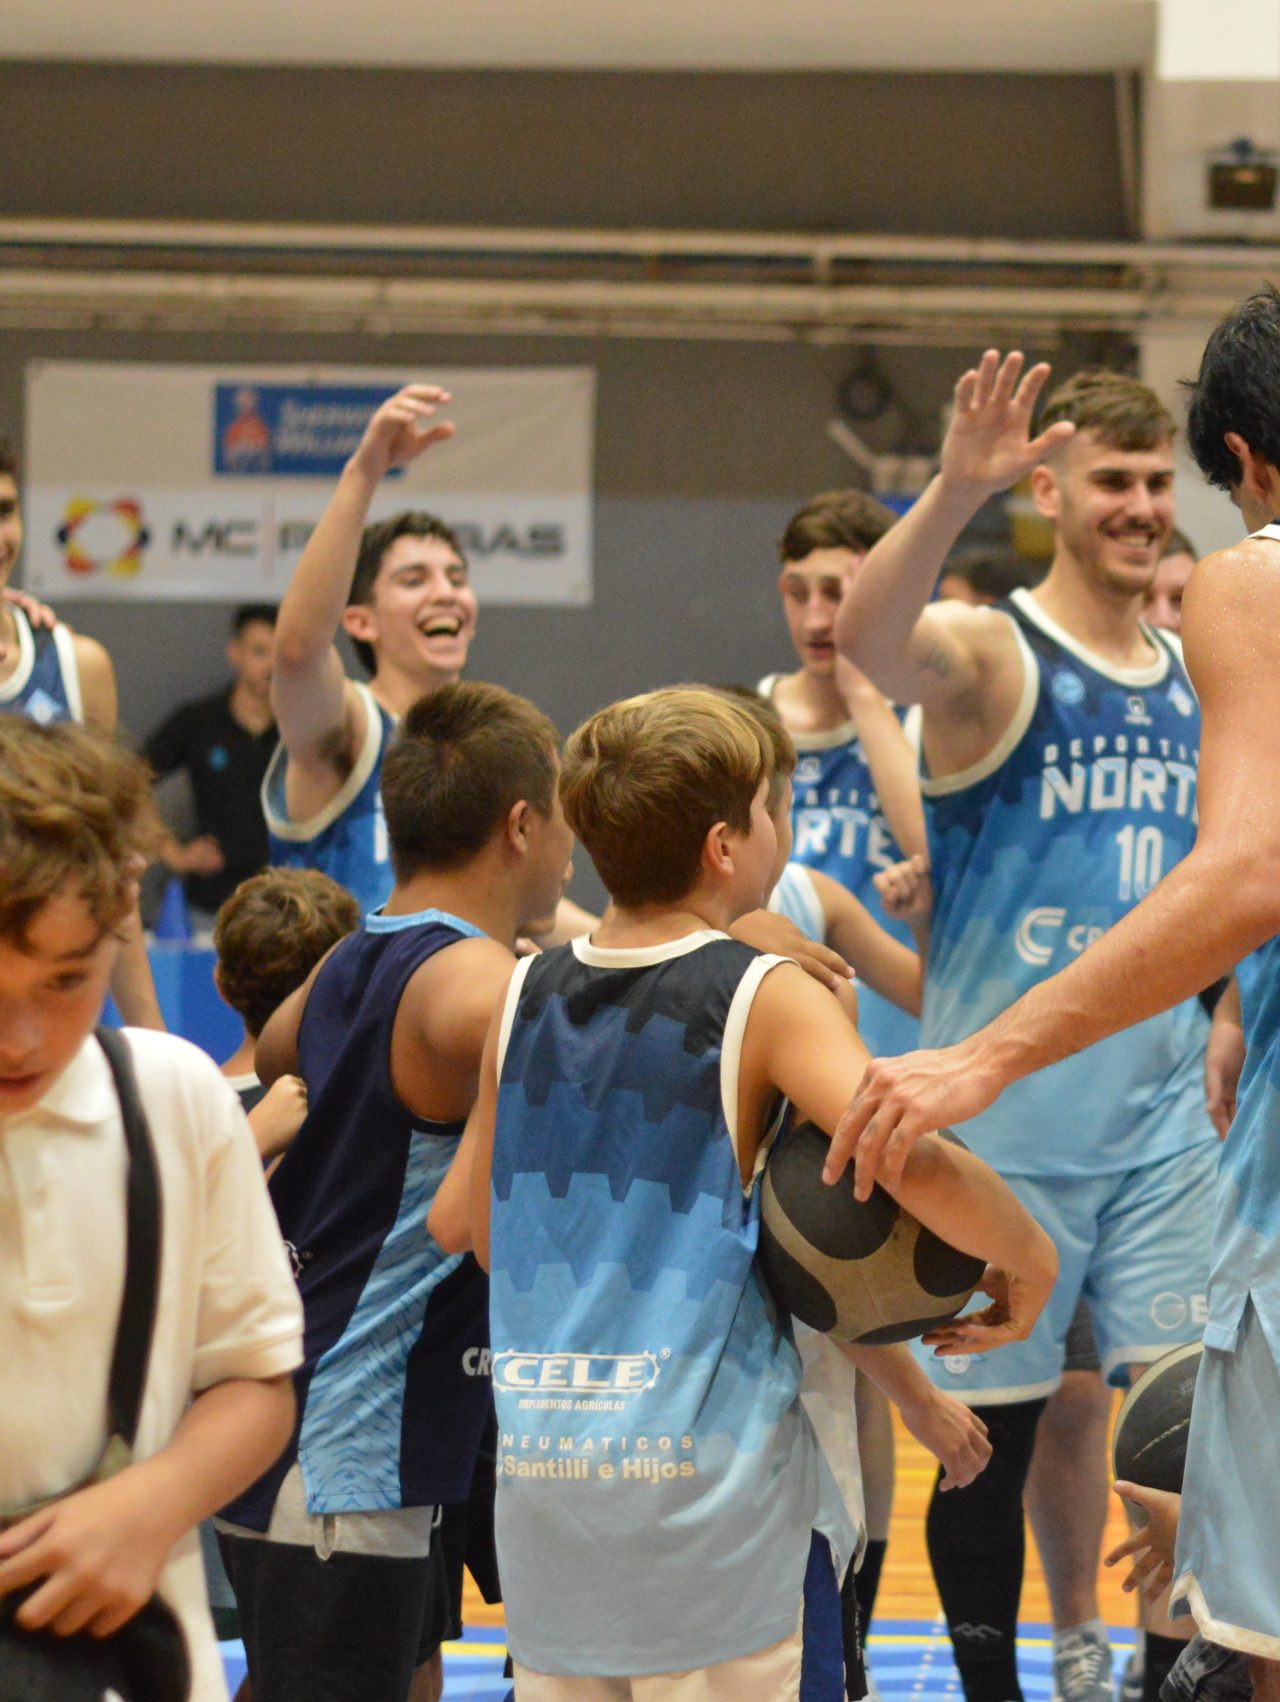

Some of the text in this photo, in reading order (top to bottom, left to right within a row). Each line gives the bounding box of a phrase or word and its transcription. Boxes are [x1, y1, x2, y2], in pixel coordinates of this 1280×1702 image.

[1040, 757, 1199, 820] NORT
[1115, 825, 1163, 901] 10
[503, 1358, 647, 1388] CELE
[502, 1433, 693, 1450] NEUMATICOS
[504, 1454, 696, 1484] Santilli e Hijos
